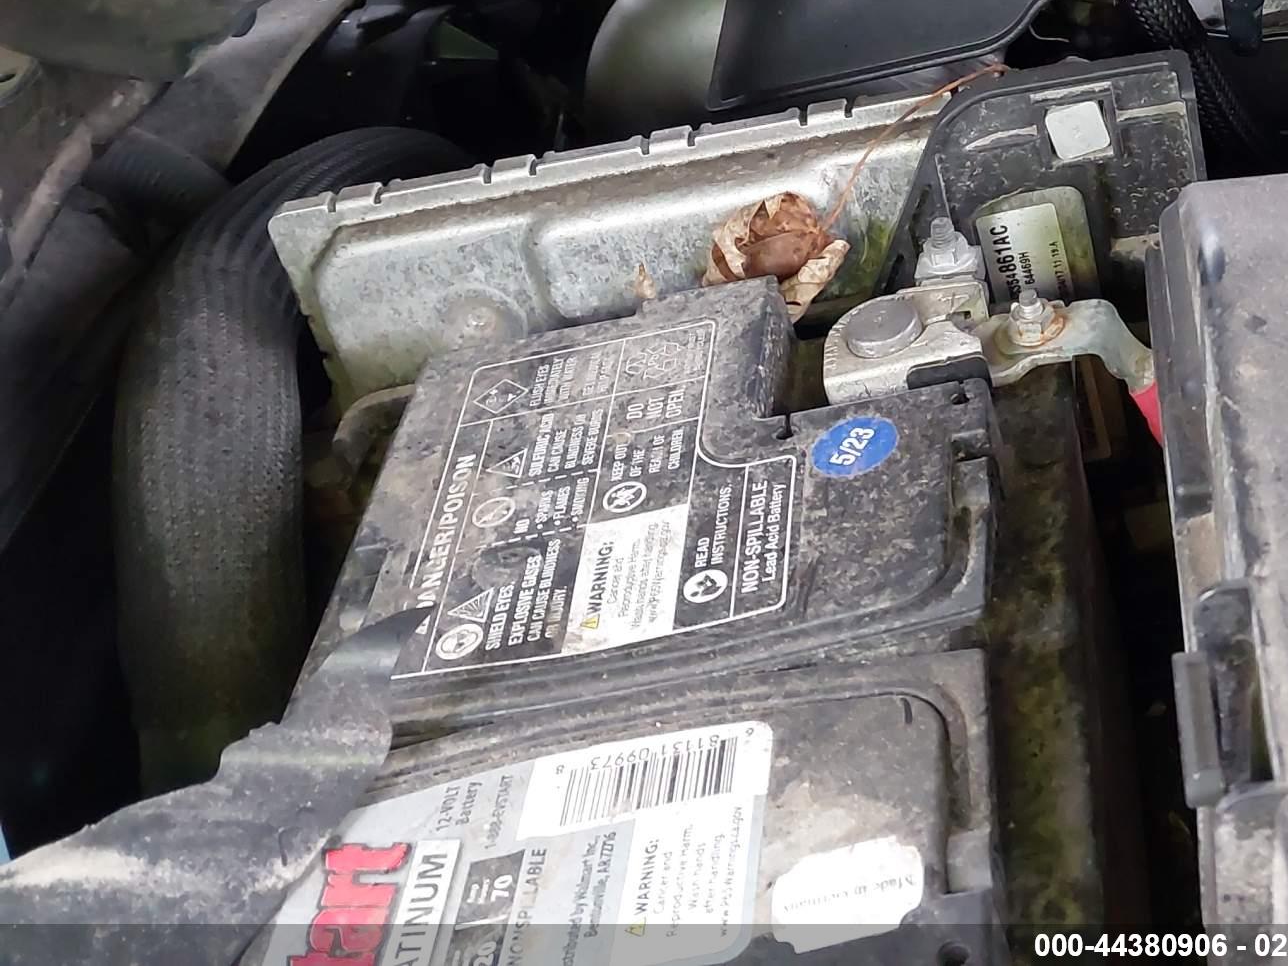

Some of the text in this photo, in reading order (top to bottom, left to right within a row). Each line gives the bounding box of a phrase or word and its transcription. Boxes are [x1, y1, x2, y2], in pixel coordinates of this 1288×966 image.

[1018, 250, 1036, 285] 64469H
[626, 402, 645, 420] DO
[646, 396, 665, 420] NOT
[528, 433, 551, 477] SULFURIC
[546, 429, 568, 473] CAN CAUSE
[564, 425, 585, 469] BLINDNESS
[581, 435, 599, 466] SEVERE
[652, 433, 665, 446] OF
[829, 427, 876, 467] 5/23
[610, 443, 628, 482] KEEP OUT
[629, 447, 646, 478] OF THE
[552, 485, 571, 521] FLAMES
[571, 477, 590, 516] SMOKING
[513, 518, 531, 534] NO
[710, 482, 733, 565] INSTRUCTIONS.
[740, 479, 768, 594] NON-SPILLABLE
[761, 482, 787, 583] Lead Acid Battery
[694, 537, 711, 569] READ
[526, 538, 561, 642] CAN CAUSE BLINDNESS
[586, 540, 614, 615] WARNING:
[507, 553, 543, 646] EXPLOSIVE GASES
[485, 612, 508, 651] SHIELD
[590, 746, 650, 772] 09973
[435, 785, 462, 832] 12-VOLT
[455, 781, 483, 826] Battery
[490, 874, 514, 903] 70
[634, 838, 660, 916] WARNING:
